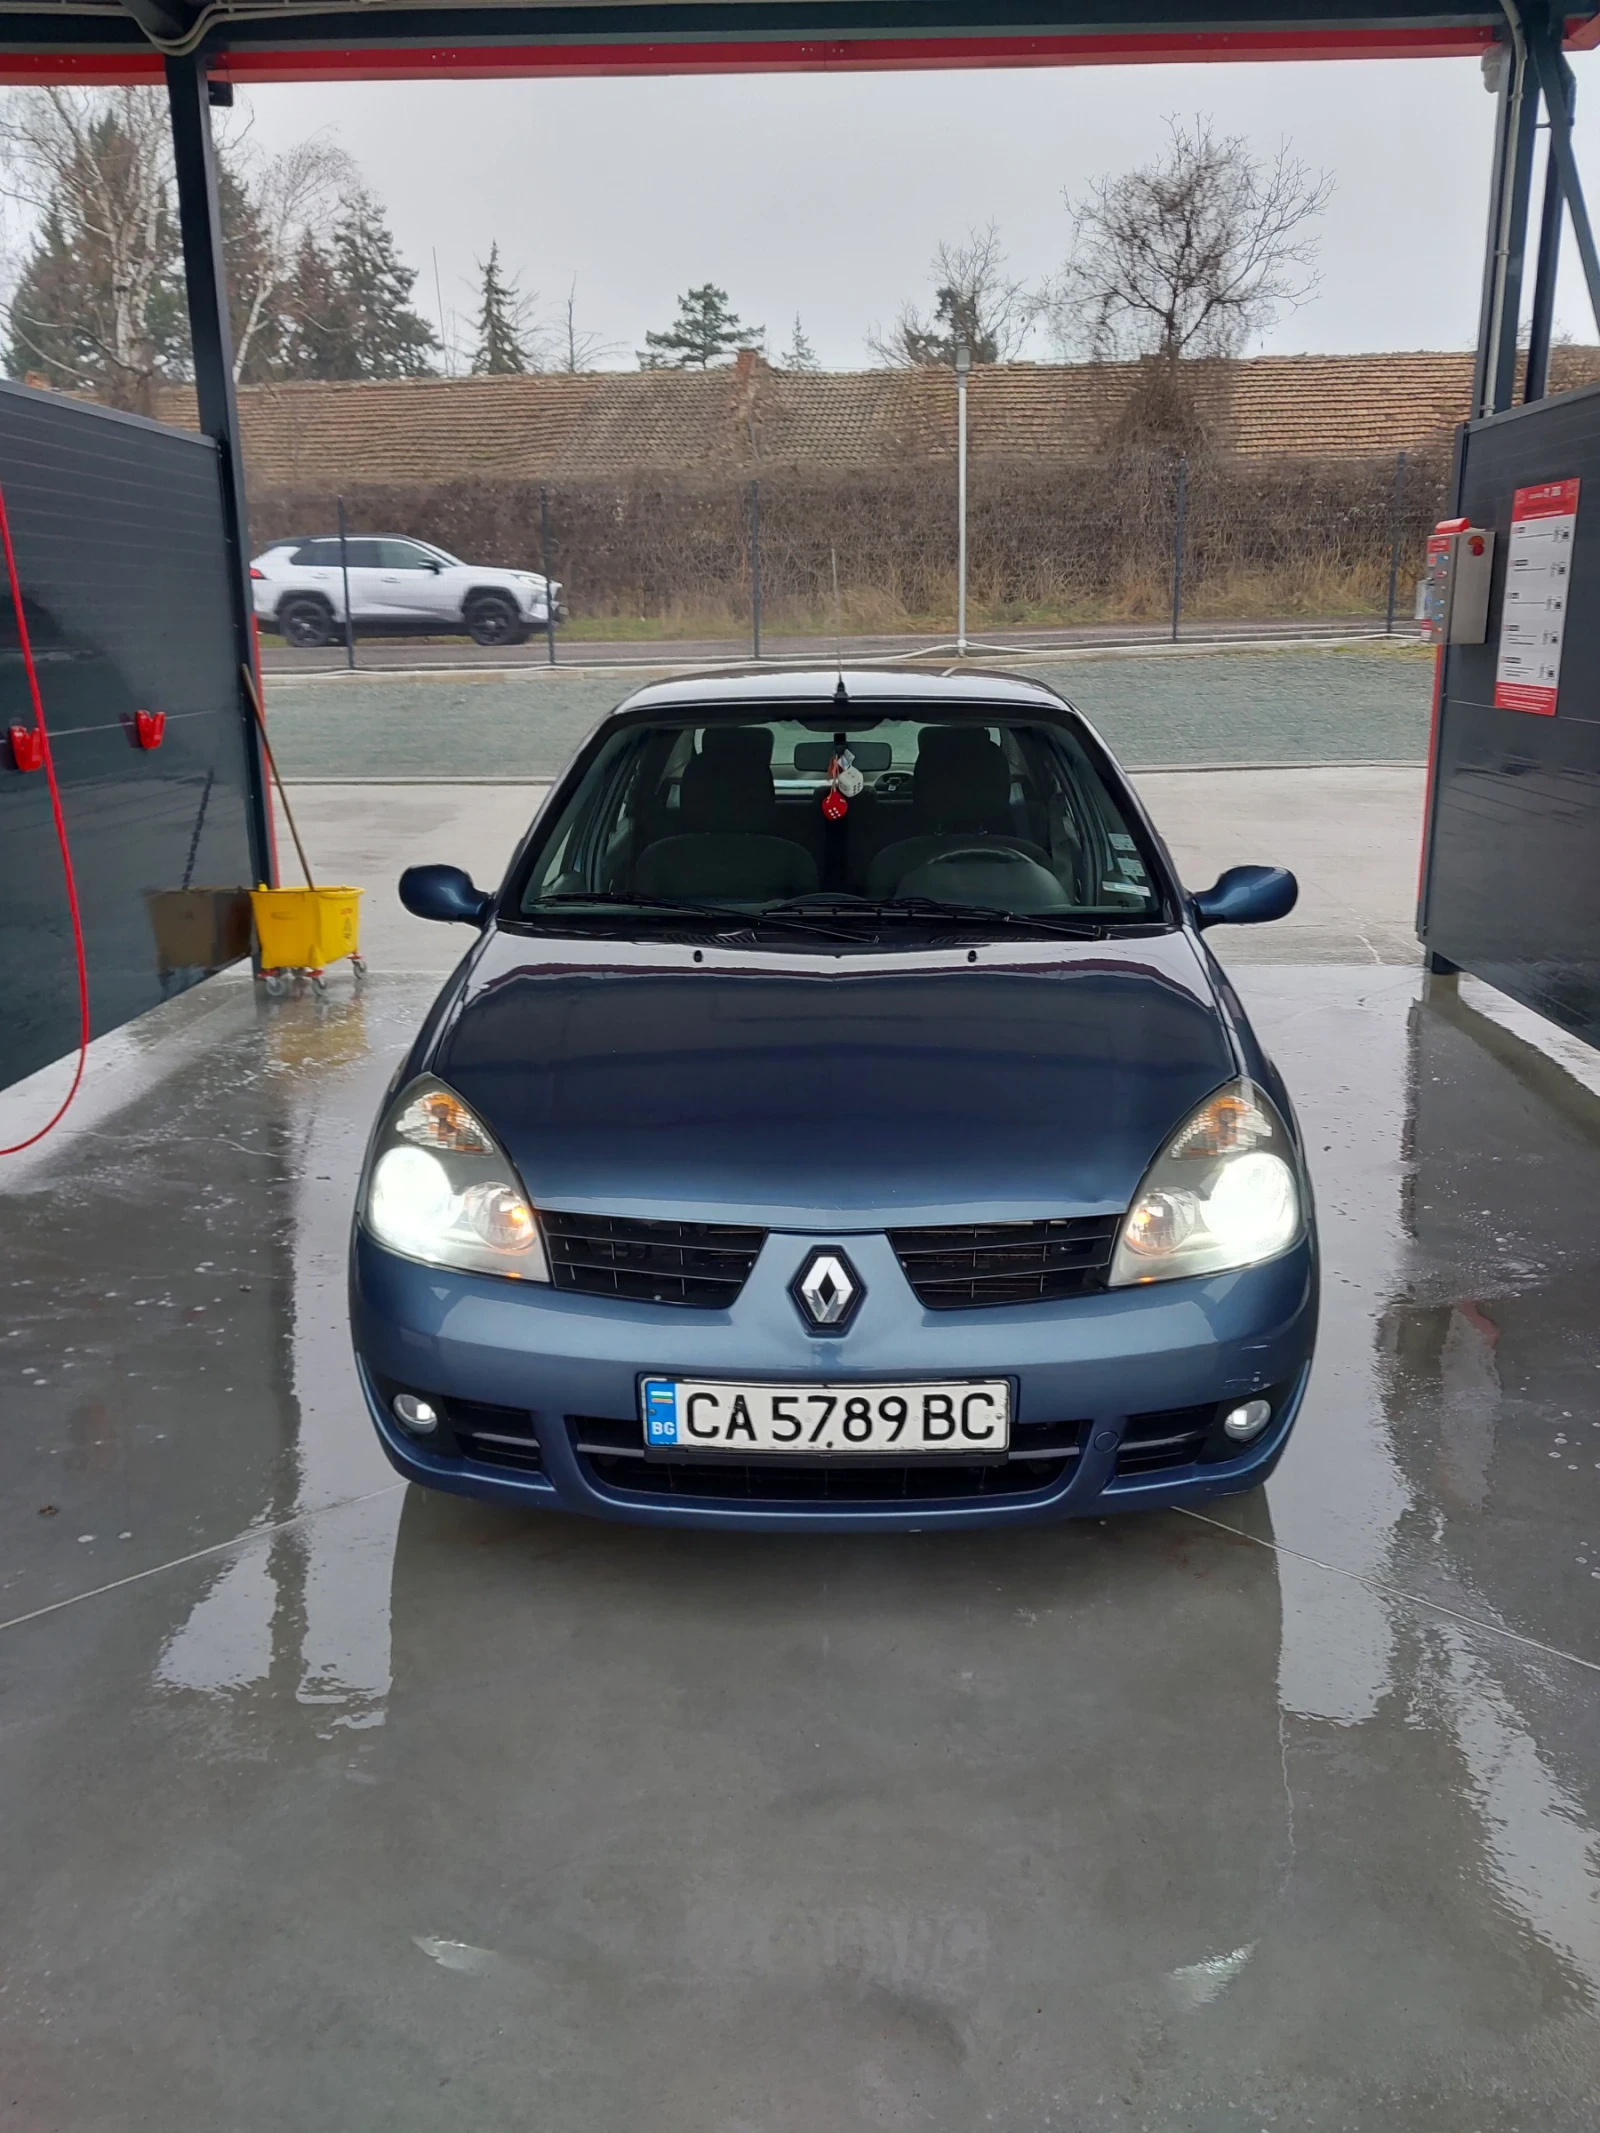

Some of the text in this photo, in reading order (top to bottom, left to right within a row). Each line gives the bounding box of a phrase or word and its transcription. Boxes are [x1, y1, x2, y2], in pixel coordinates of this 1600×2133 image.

[652, 1421, 675, 1436] BG
[686, 1392, 995, 1442] CA 5789 BC
